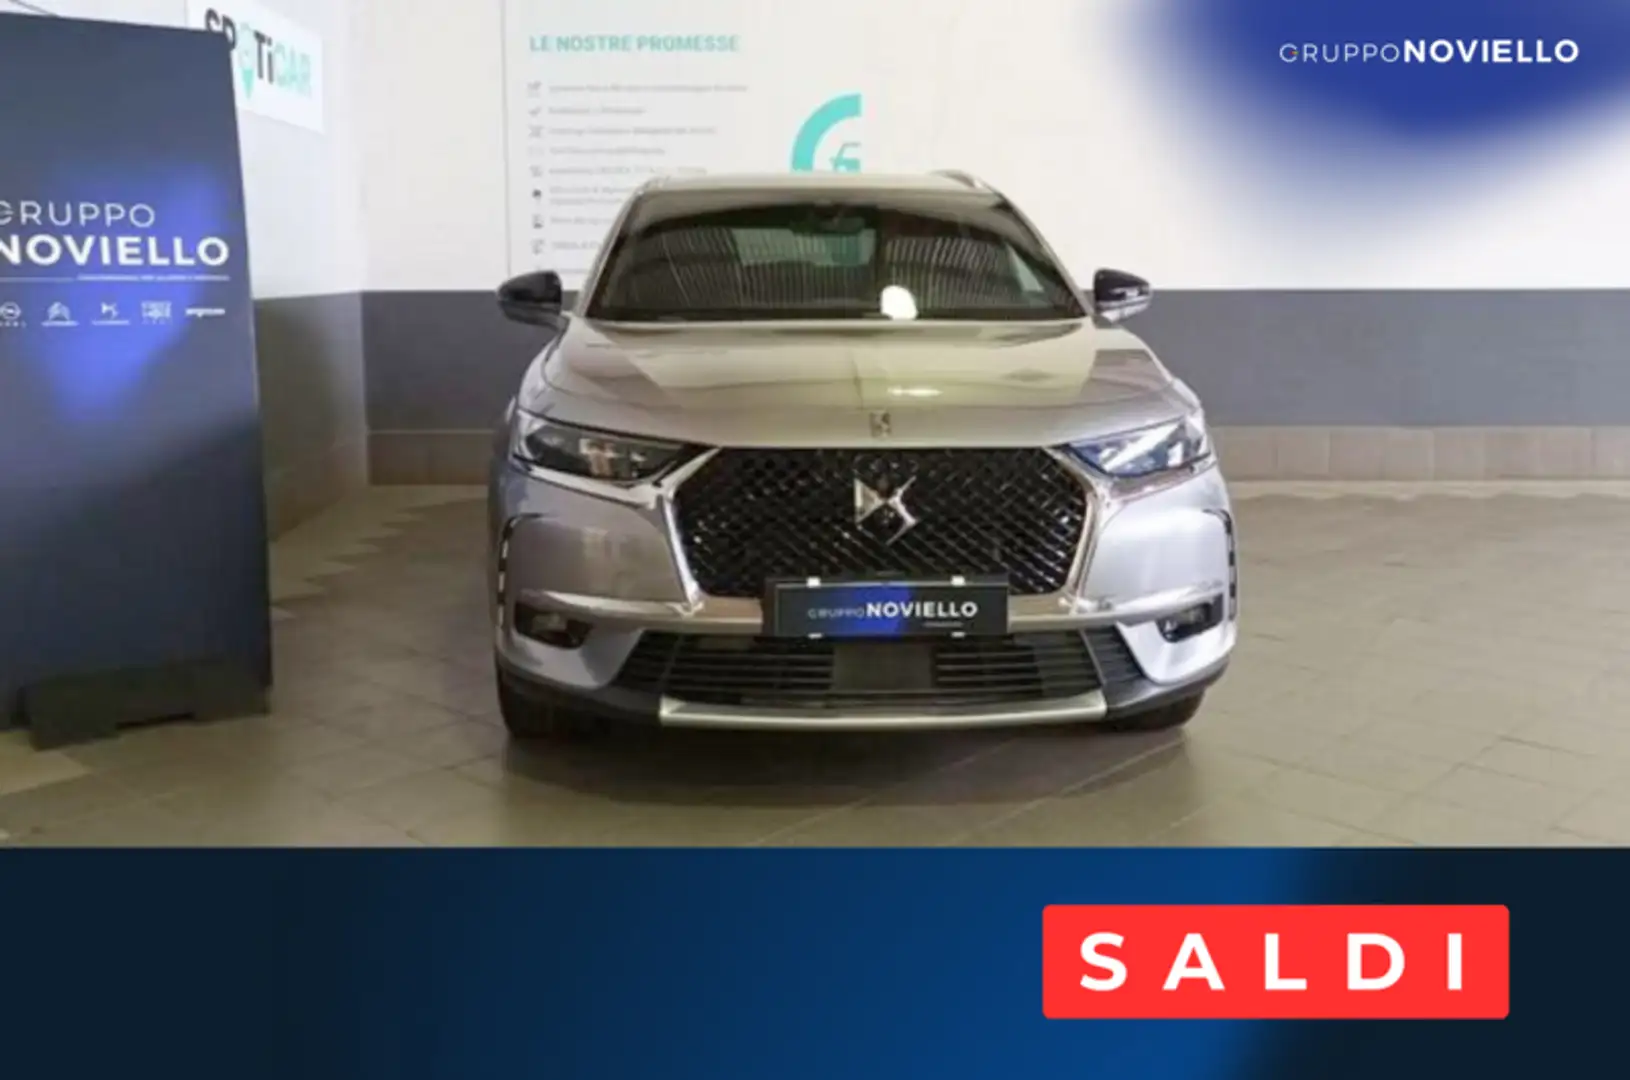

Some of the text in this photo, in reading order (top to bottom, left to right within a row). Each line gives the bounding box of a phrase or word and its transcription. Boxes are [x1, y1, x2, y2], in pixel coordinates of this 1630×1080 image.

[529, 35, 740, 52] LE NOSTRE PROMESSE
[0, 233, 229, 266] NOVIELLO
